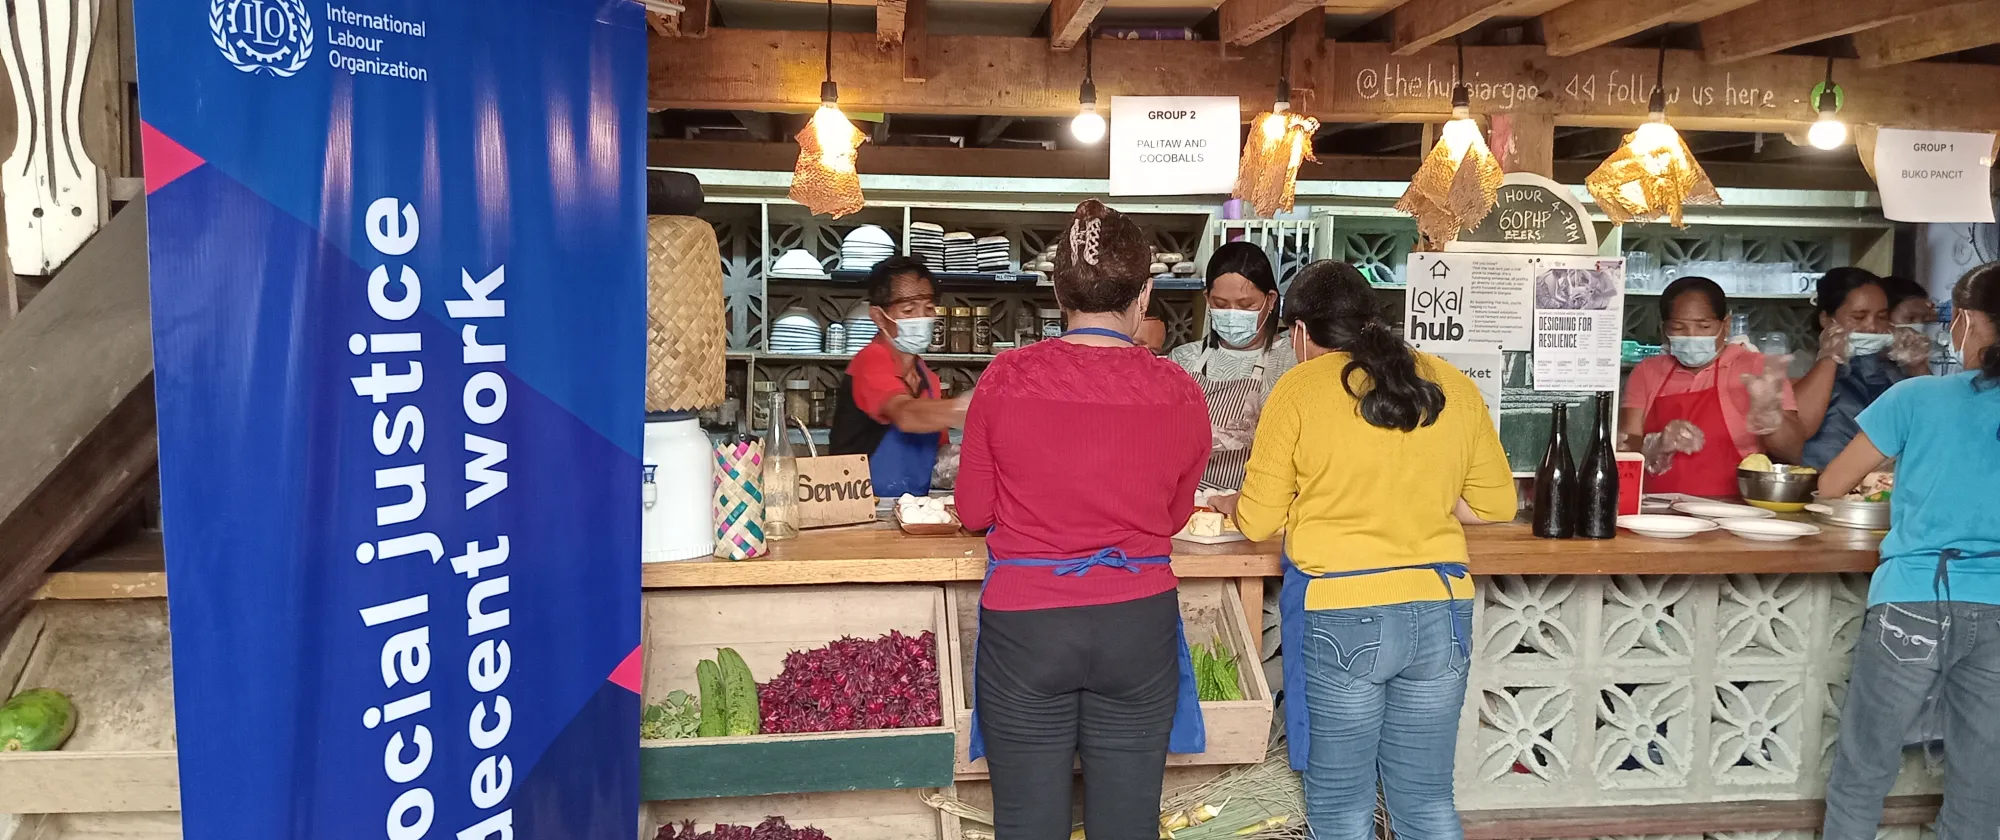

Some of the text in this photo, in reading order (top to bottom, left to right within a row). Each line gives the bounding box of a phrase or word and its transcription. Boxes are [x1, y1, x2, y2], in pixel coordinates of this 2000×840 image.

[242, 1, 285, 46] ILO
[326, 2, 427, 38] International
[328, 26, 383, 52] Labour
[328, 50, 428, 82] Organization
[1692, 86, 1714, 106] us
[1725, 72, 1776, 107] here
[1148, 110, 1196, 120] GROUP 2
[1137, 139, 1207, 148] PALITAW AND
[1913, 143, 1954, 152] GROUP 1
[1139, 153, 1204, 163] COCOBALLS
[1901, 170, 1964, 179] BUKO PANCIT
[1505, 189, 1543, 203] HOUR
[1411, 315, 1464, 341] hub
[1539, 317, 1592, 331] DESIGNING FOR
[1539, 334, 1577, 348] RESILIENCE
[1459, 367, 1492, 379] rket
[444, 263, 508, 511] work
[799, 474, 872, 503] Service
[348, 197, 445, 840] ocial justice
